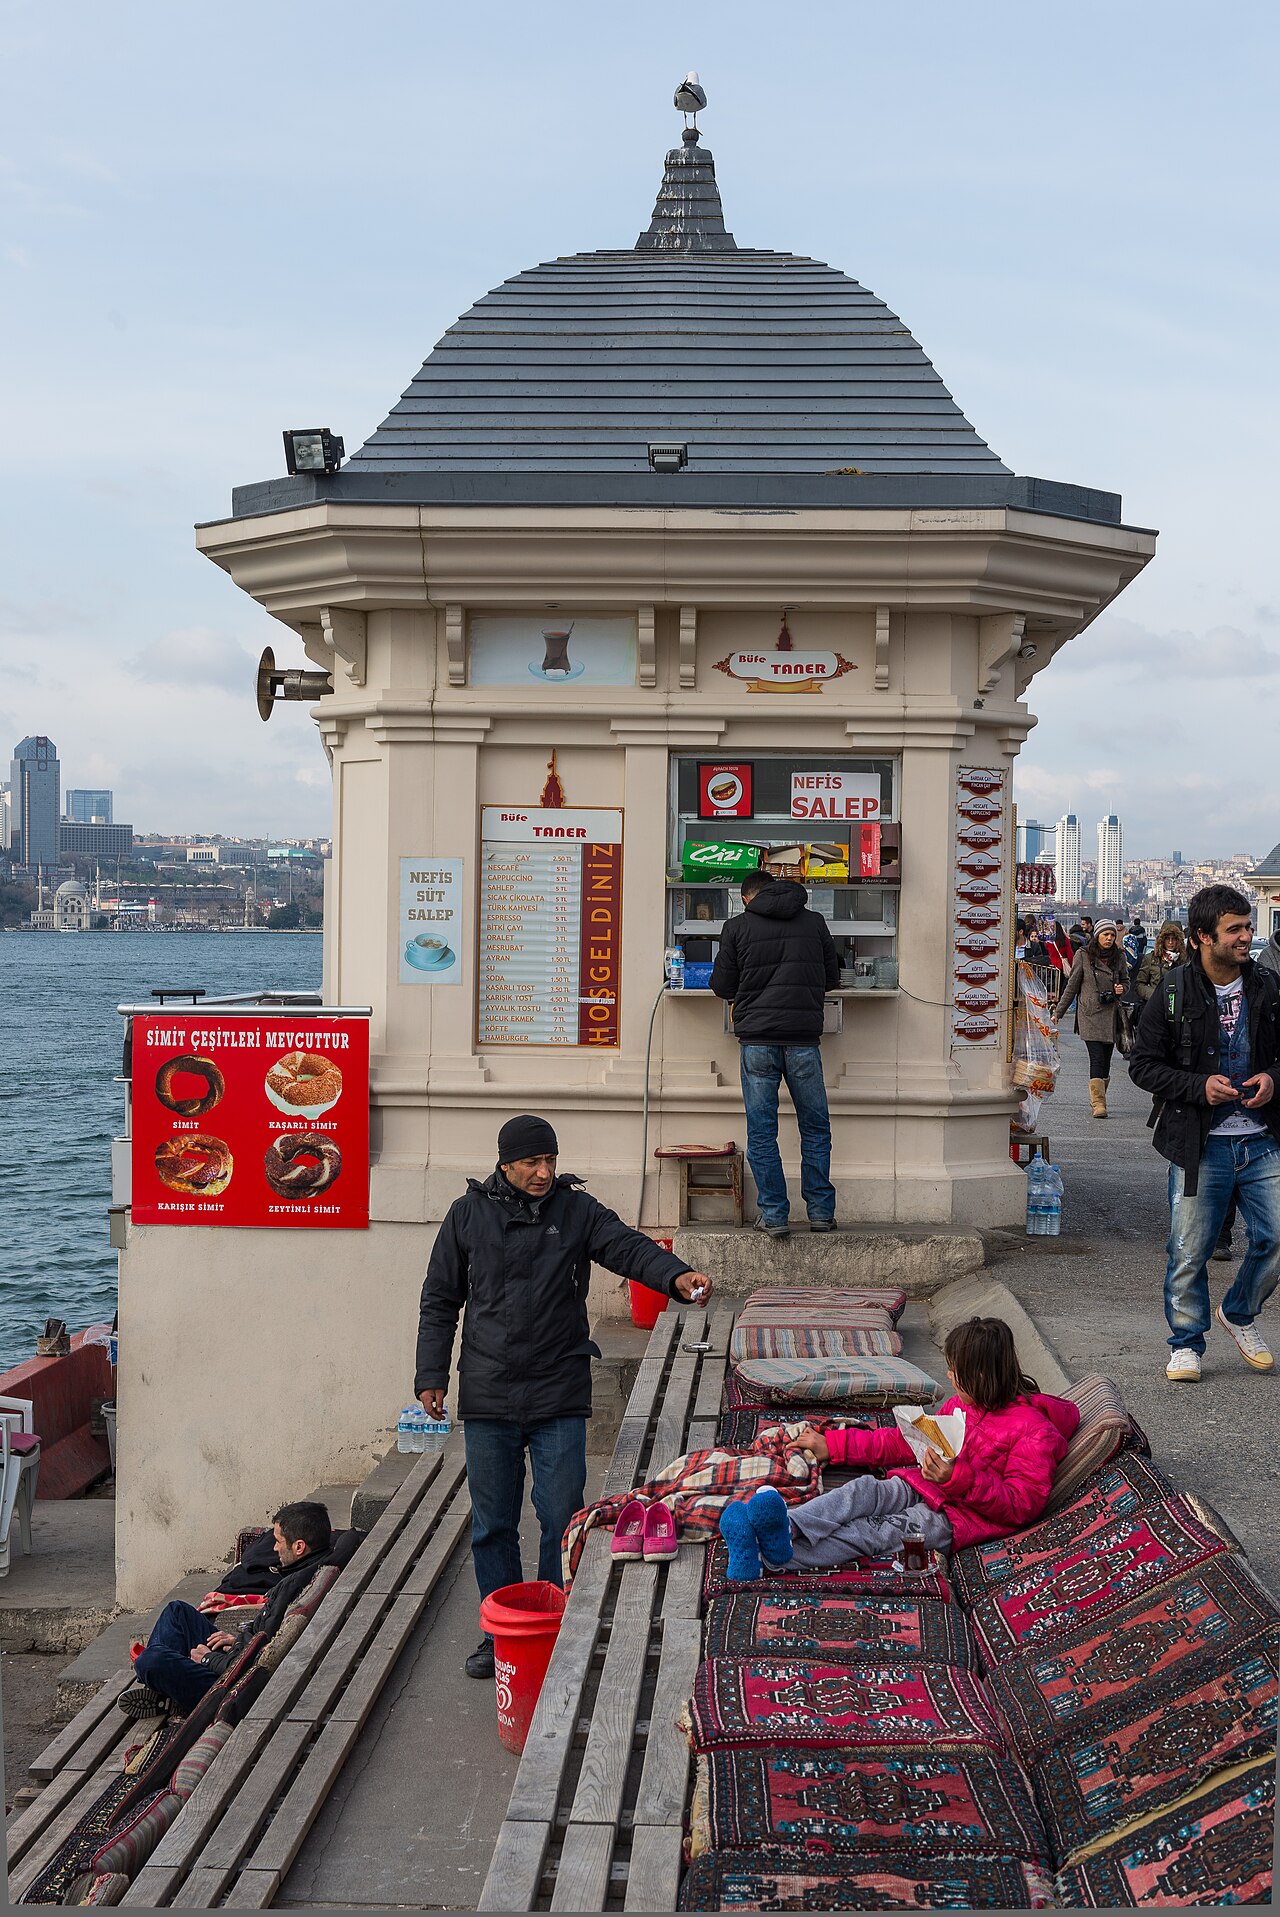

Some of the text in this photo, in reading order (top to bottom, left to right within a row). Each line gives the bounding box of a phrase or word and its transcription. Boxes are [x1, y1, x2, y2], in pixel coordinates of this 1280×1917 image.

[738, 654, 766, 663] Büfe
[770, 664, 826, 674] TANER
[794, 773, 842, 789] NEFİS
[791, 796, 879, 818] SALEP
[500, 813, 528, 822] Büfe
[532, 826, 587, 838] TANER
[410, 868, 452, 884] NEFİS
[416, 887, 445, 902] SÜT
[408, 909, 454, 921] SALEP
[146, 1026, 350, 1052] SİMİT ÇEŞİTLERİ MEVCUTTUR
[172, 1120, 199, 1129] SİMİT
[268, 1120, 338, 1131] KAŞARLI SİMİT
[158, 1202, 225, 1212] KARIŞIK SİMİT
[268, 1204, 341, 1214] ZEYTİNLİ SİMİT
